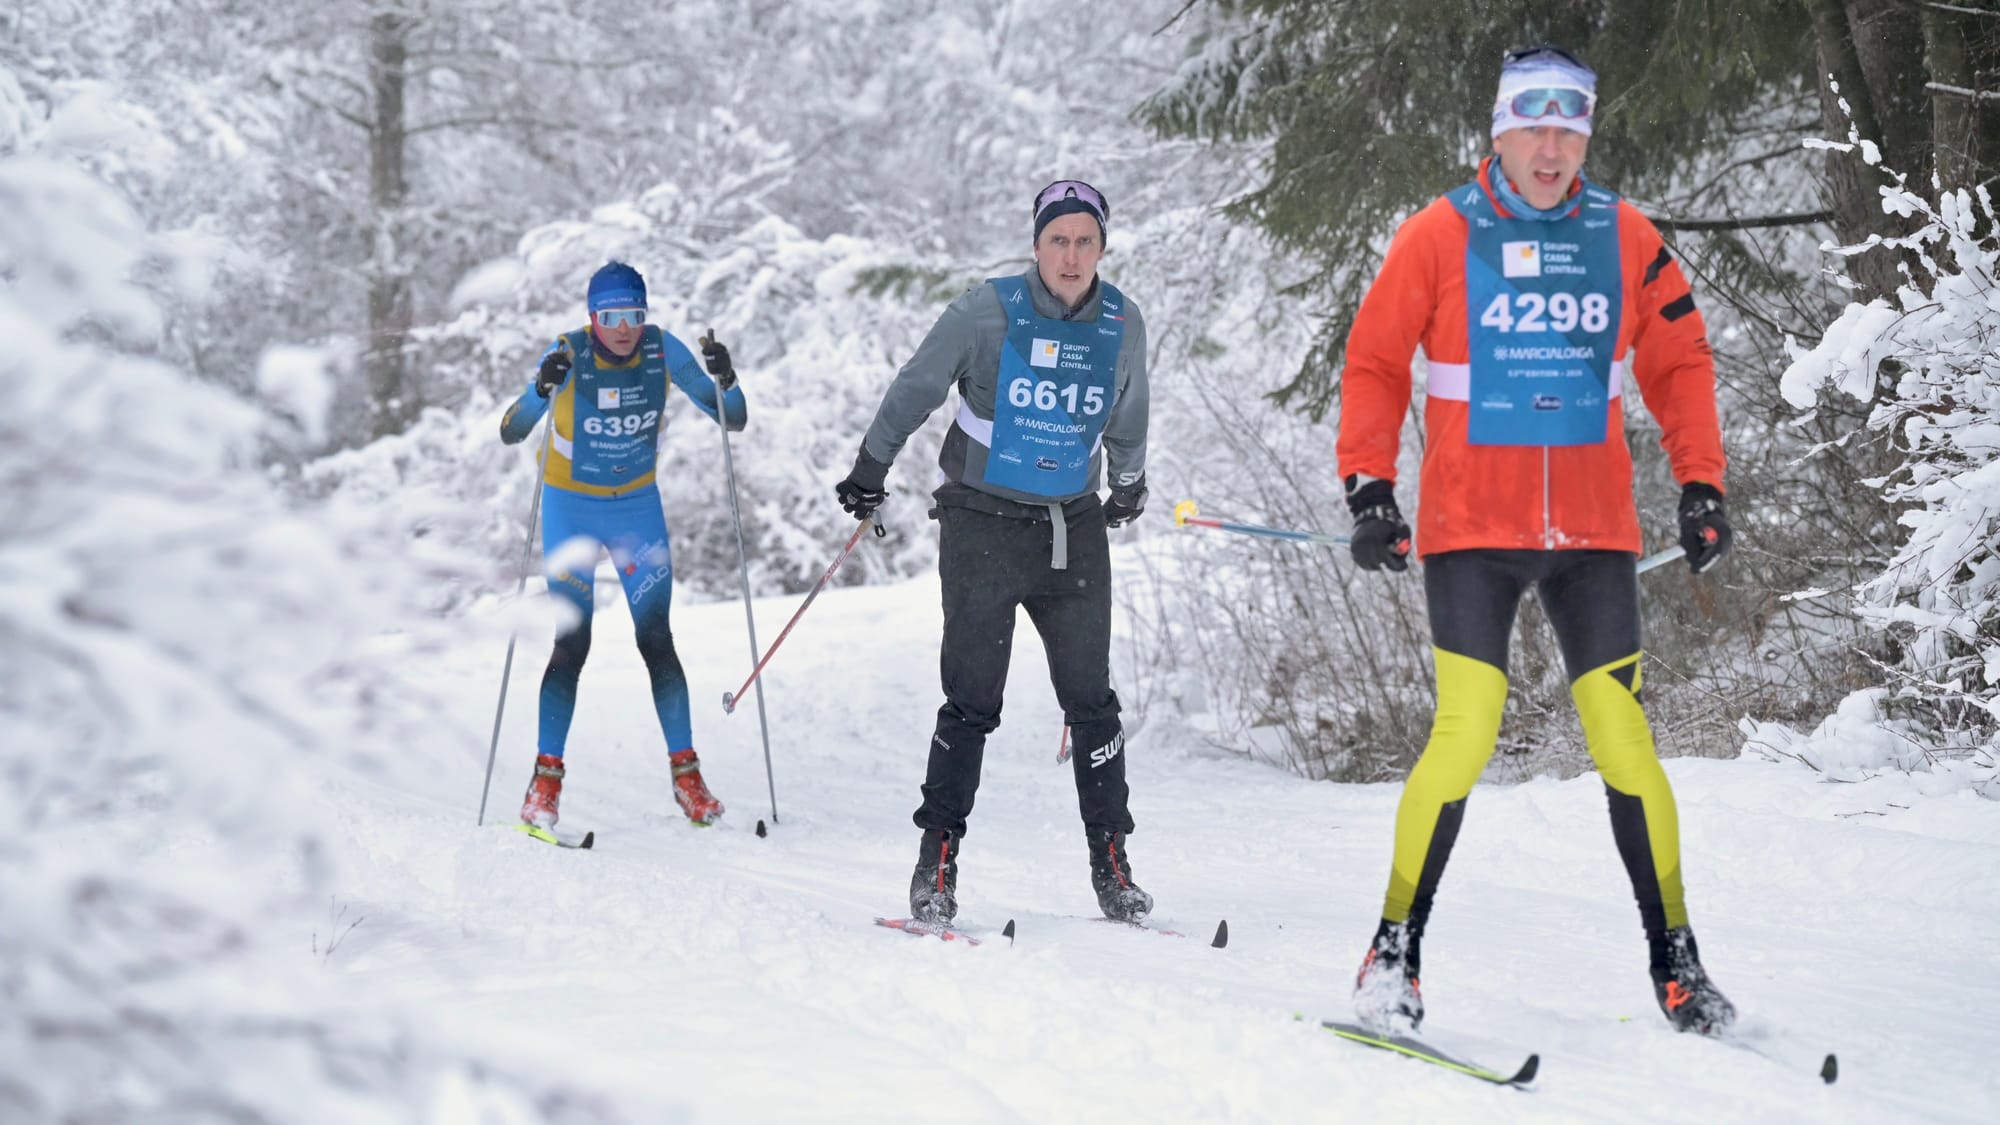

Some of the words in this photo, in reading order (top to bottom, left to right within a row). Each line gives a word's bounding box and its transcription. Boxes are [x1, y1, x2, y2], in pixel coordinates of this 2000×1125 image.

[1543, 253, 1573, 263] CASSA
[1480, 292, 1610, 333] 4298
[1063, 343, 1091, 353] GRUPPO
[1508, 347, 1595, 360] MARCIALONGA
[1061, 352, 1084, 361] CASSA
[1060, 361, 1092, 371] CENTRALE
[1008, 377, 1105, 415] 6615
[583, 410, 658, 437] 6392
[1024, 418, 1087, 434] MARCIALONGA
[631, 566, 669, 605] odlo
